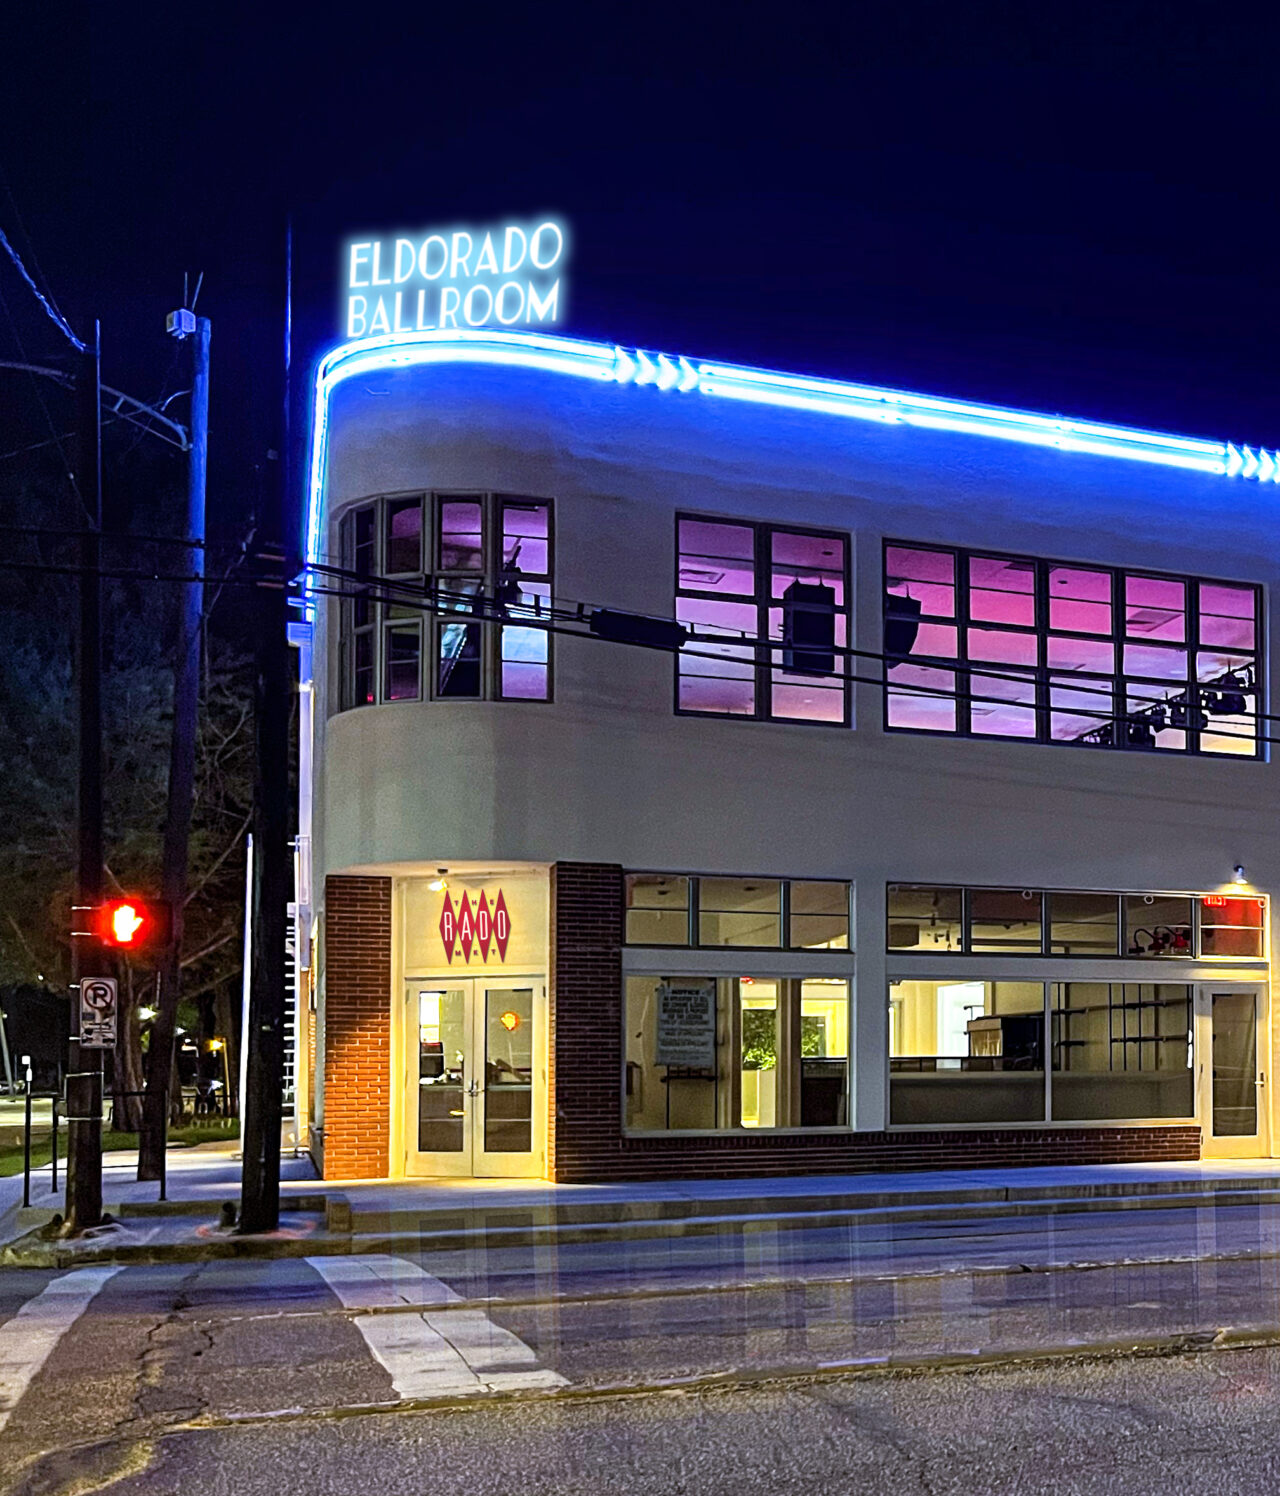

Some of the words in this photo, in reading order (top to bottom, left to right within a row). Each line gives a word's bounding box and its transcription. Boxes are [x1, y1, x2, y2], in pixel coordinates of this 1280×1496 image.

[349, 222, 563, 288] ELDORADO
[347, 278, 560, 337] BALLROOM
[444, 910, 506, 941] RADO
